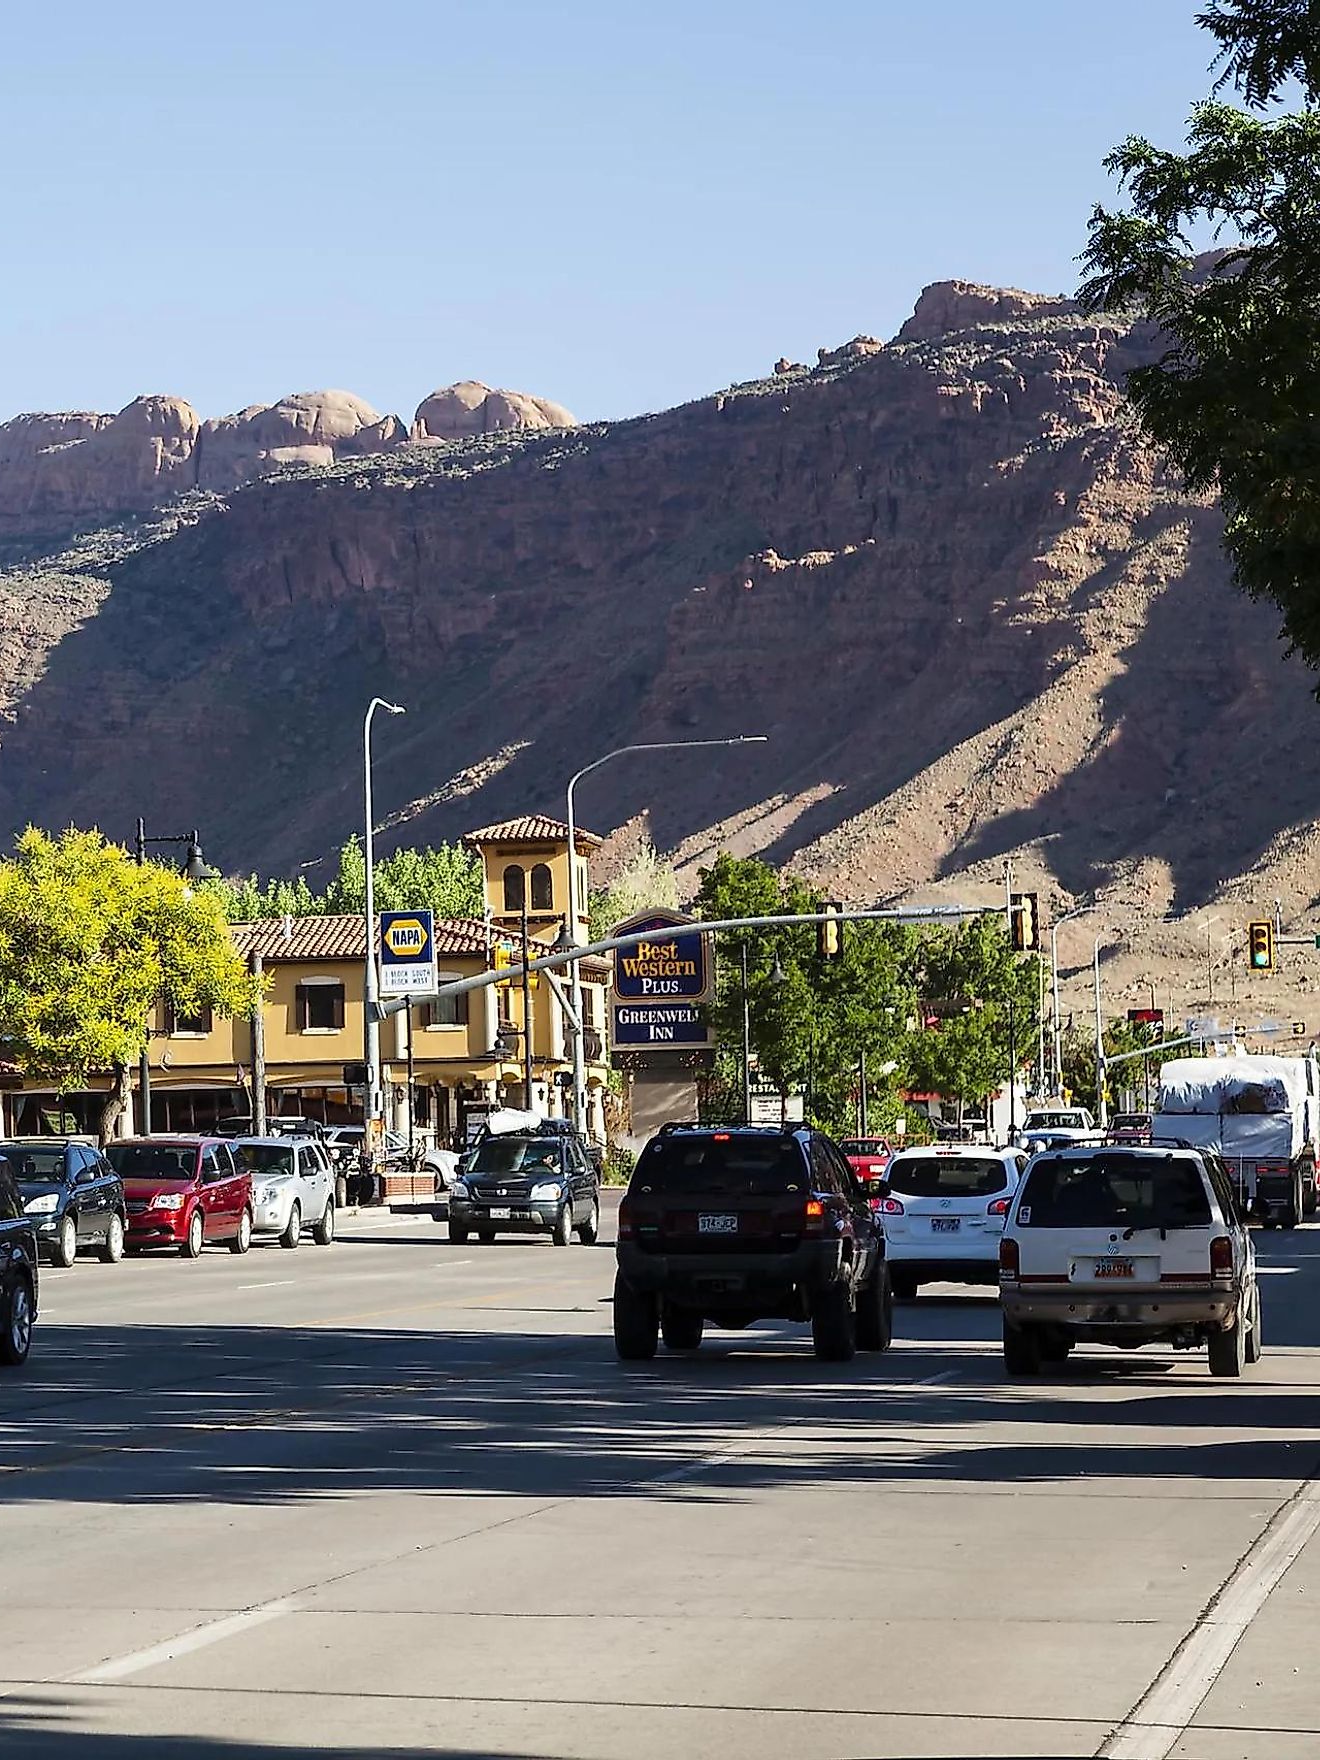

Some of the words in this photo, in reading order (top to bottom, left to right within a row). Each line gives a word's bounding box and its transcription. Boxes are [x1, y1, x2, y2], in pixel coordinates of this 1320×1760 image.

[392, 930, 421, 946] NAPA
[637, 941, 679, 961] Best
[622, 959, 696, 977] Western
[648, 1025, 674, 1040] INN
